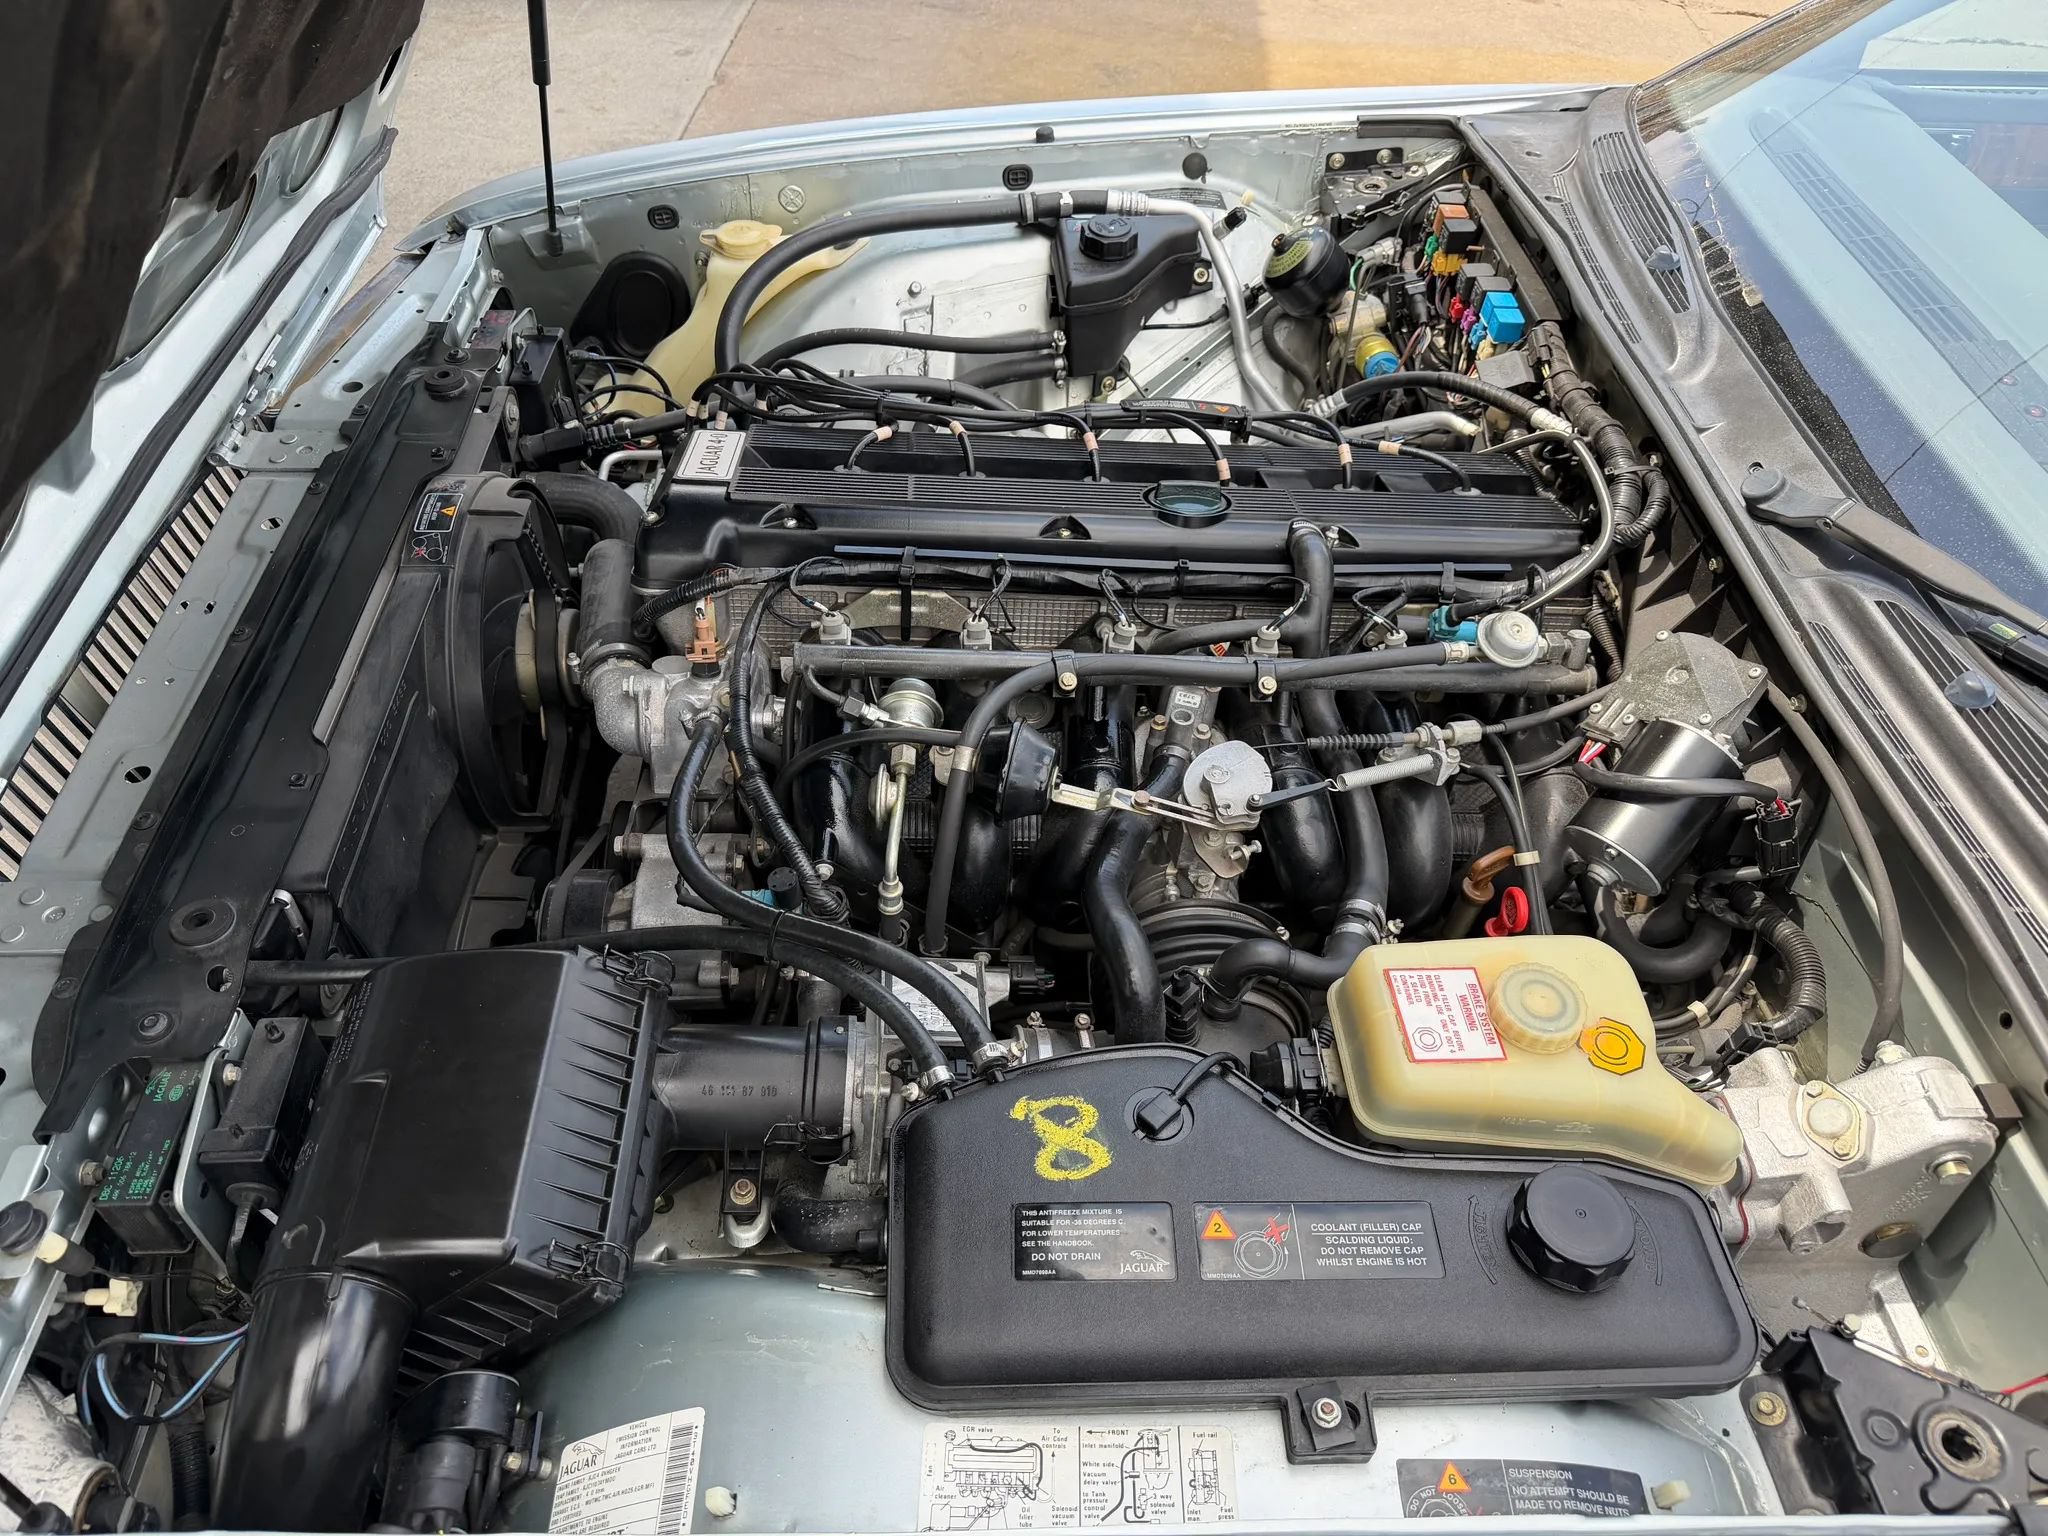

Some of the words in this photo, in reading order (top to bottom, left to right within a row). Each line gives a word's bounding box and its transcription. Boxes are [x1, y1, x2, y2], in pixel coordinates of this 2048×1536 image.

[696, 446, 724, 475] JAGUAR
[1410, 982, 1422, 1002] SEALED
[1417, 974, 1426, 988] FLUID
[1423, 991, 1432, 1006] FROM
[1434, 975, 1444, 991] CLEAN
[1453, 1030, 1465, 1051] BEFORE
[1459, 994, 1479, 1031] WARNING
[1468, 984, 1484, 1009] BRAKE
[1478, 1010, 1496, 1045] SYSTEM
[1436, 1005, 1444, 1015] USE
[1440, 1019, 1450, 1034] ONLY
[1446, 1036, 1454, 1048] DOT
[153, 1071, 172, 1101] JAGUAR
[1009, 1095, 1112, 1182] 8
[99, 1185, 112, 1200] DBC
[109, 1156, 124, 1180] 11206
[1214, 1223, 1221, 1233] 2
[1311, 1223, 1357, 1232] COOLANT
[1360, 1223, 1399, 1232] (FILLER)
[1402, 1223, 1422, 1231] CAP
[1325, 1236, 1374, 1244] SCALDING
[1378, 1236, 1413, 1244] LIQUID:
[1032, 1253, 1045, 1261] DO
[1321, 1247, 1336, 1255] DO
[1405, 1246, 1424, 1254] CAP
[1120, 1263, 1163, 1274] JAGUAR
[1317, 1258, 1354, 1266] WHILST
[1407, 1257, 1427, 1265] HOT
[616, 1432, 638, 1443] EMISSION
[639, 1426, 661, 1437] CONTROL
[629, 1421, 647, 1431] VEHICLE
[620, 1437, 652, 1449] INFORMATION
[614, 1448, 633, 1460] JAGUAR
[634, 1445, 647, 1454] CARS
[559, 1455, 597, 1480] JAGUAR
[1509, 1468, 1572, 1480] SUSPENSION
[1448, 1474, 1457, 1485] 6
[1410, 1499, 1419, 1510] DO
[1420, 1489, 1436, 1499] NOT
[1513, 1486, 1526, 1495] NO
[1528, 1487, 1574, 1497] ATTEMPT
[1577, 1488, 1615, 1502] SHOULD
[1617, 1495, 1629, 1505] BE
[1515, 1500, 1545, 1510] MADE
[1547, 1500, 1561, 1510] TO
[1564, 1501, 1603, 1514] REMOVE
[1605, 1507, 1629, 1517] NUTS
[589, 1521, 610, 1531] REQUIRED
[592, 1513, 608, 1523] ENGINE
